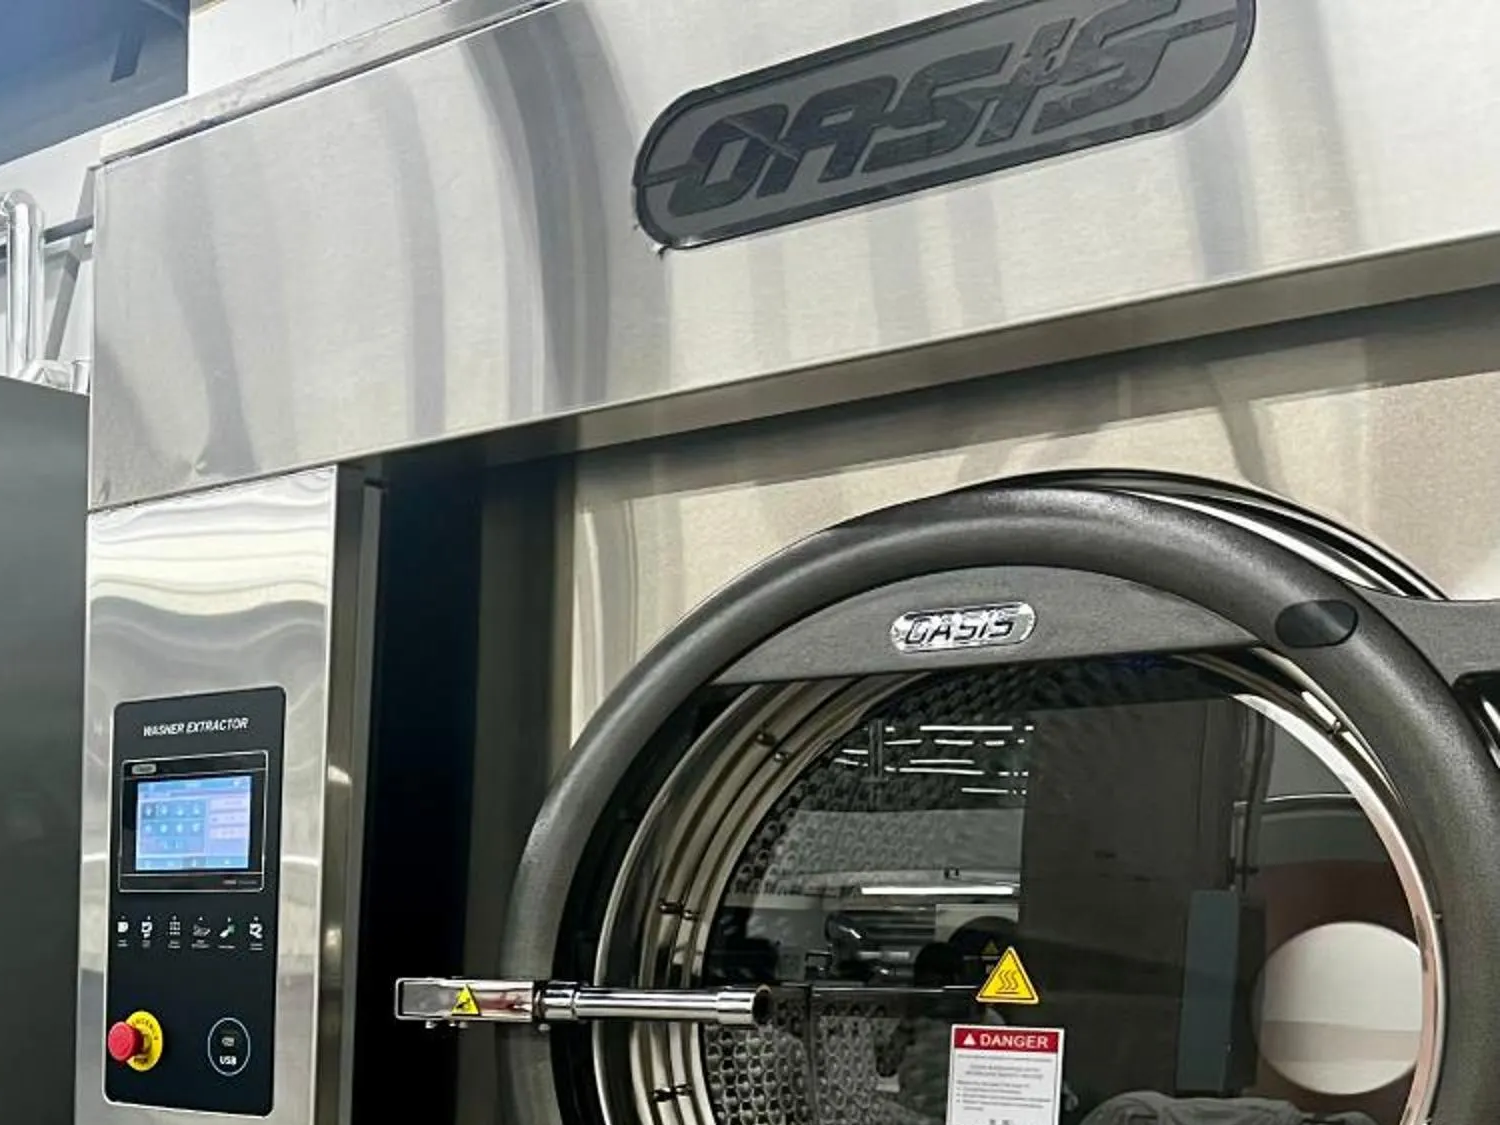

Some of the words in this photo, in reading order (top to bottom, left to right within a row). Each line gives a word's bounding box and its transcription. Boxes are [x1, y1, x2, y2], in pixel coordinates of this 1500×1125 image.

[669, 0, 1183, 217] OASIS
[903, 611, 1015, 645] OASIS
[143, 723, 185, 737] WASHER
[186, 717, 249, 734] EXTRACTOR
[979, 1033, 1049, 1049] DANGER
[219, 1055, 237, 1066] USB
